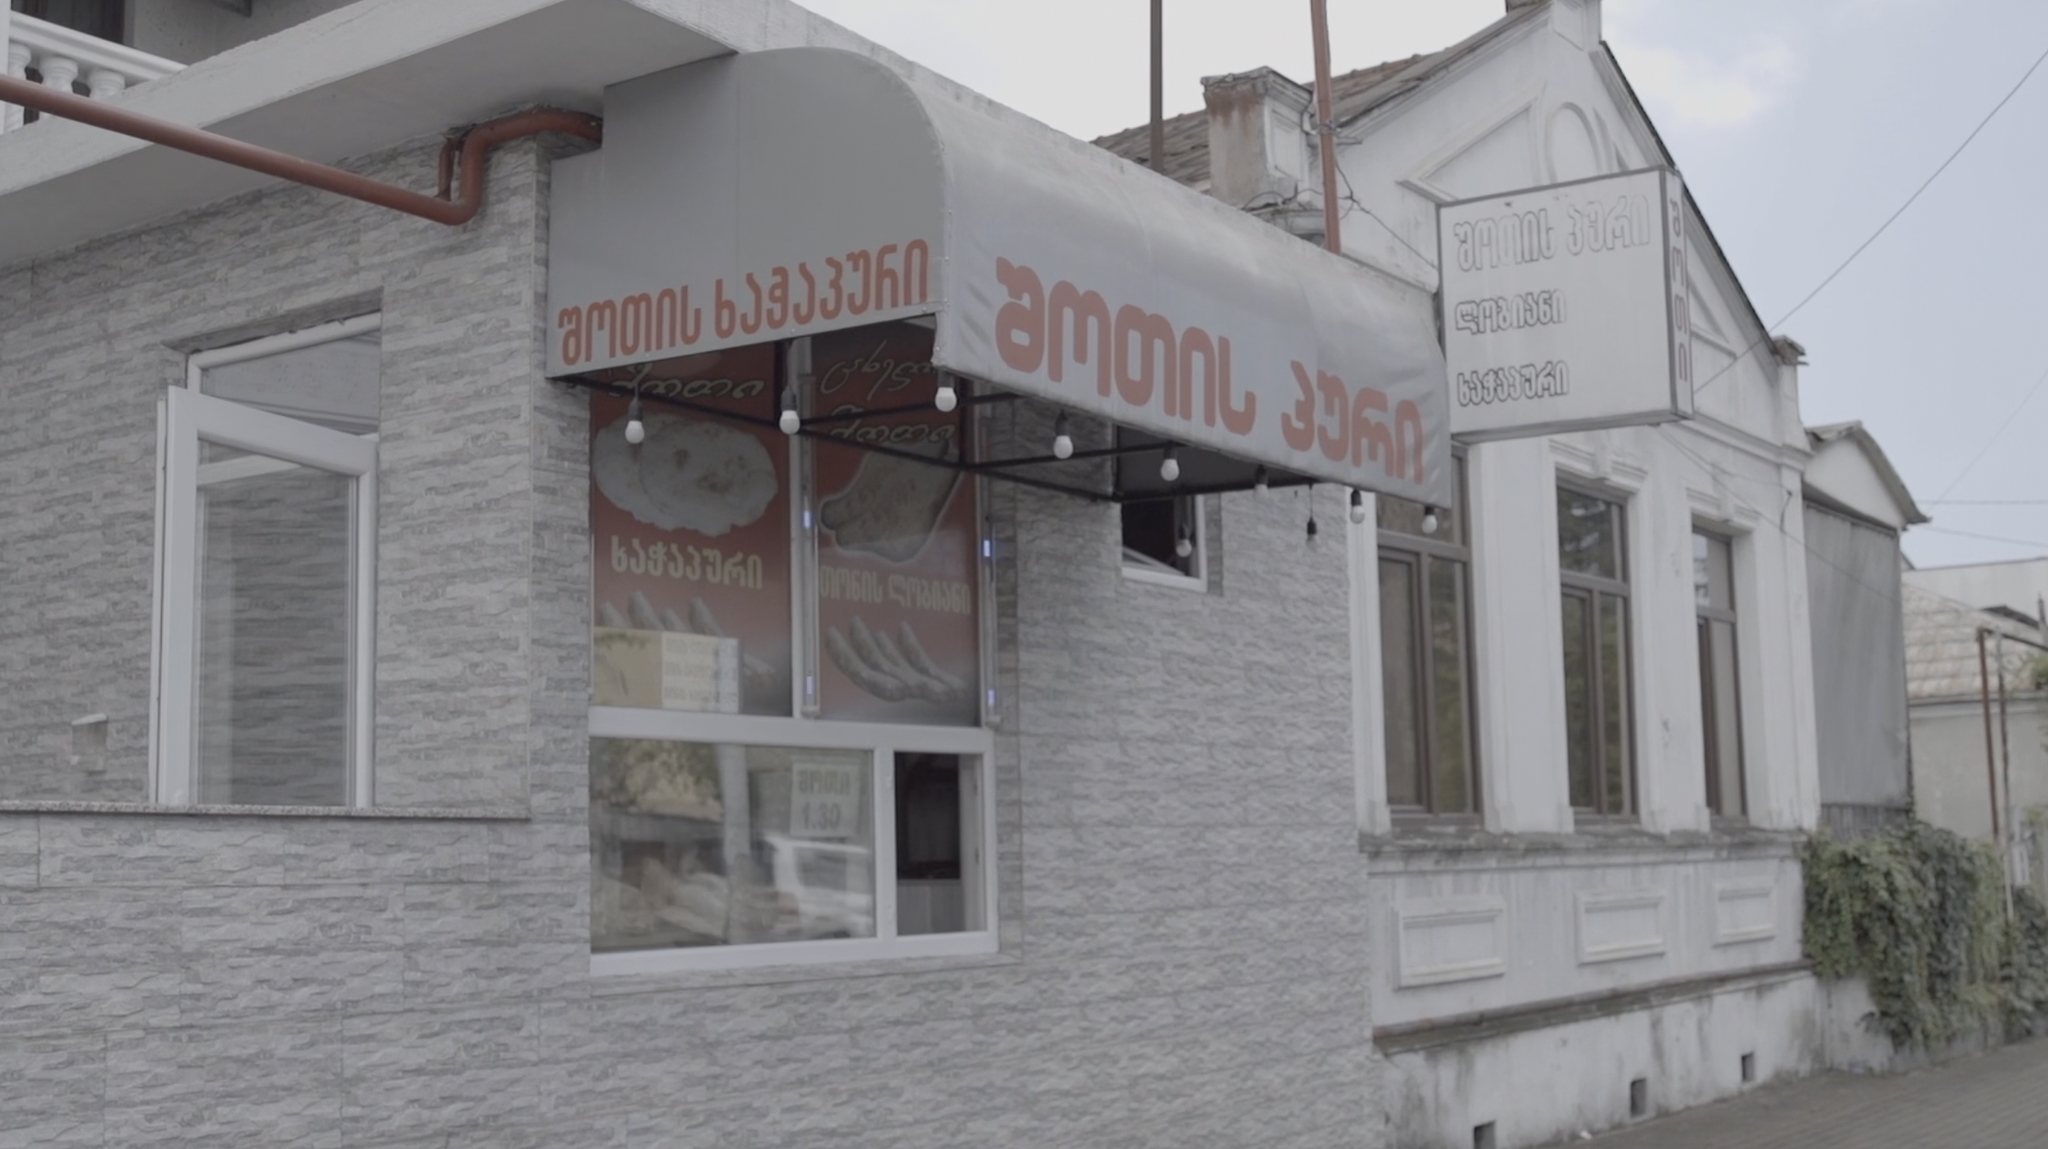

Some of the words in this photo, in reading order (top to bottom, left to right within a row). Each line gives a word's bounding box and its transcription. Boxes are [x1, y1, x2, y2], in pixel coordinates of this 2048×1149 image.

[1453, 208, 1555, 272] შოთის
[1566, 194, 1650, 256] პური
[558, 285, 702, 366] შოთის
[713, 238, 929, 340] ხაჭაპური
[1454, 288, 1567, 336] ლობიანი
[995, 256, 1257, 437] შოთის
[1280, 360, 1424, 485] პური
[1457, 360, 1570, 407] ხაჭაპური
[610, 534, 763, 590] ხაჭაპური
[820, 565, 884, 604] თონის
[887, 573, 972, 616] ლობიანი
